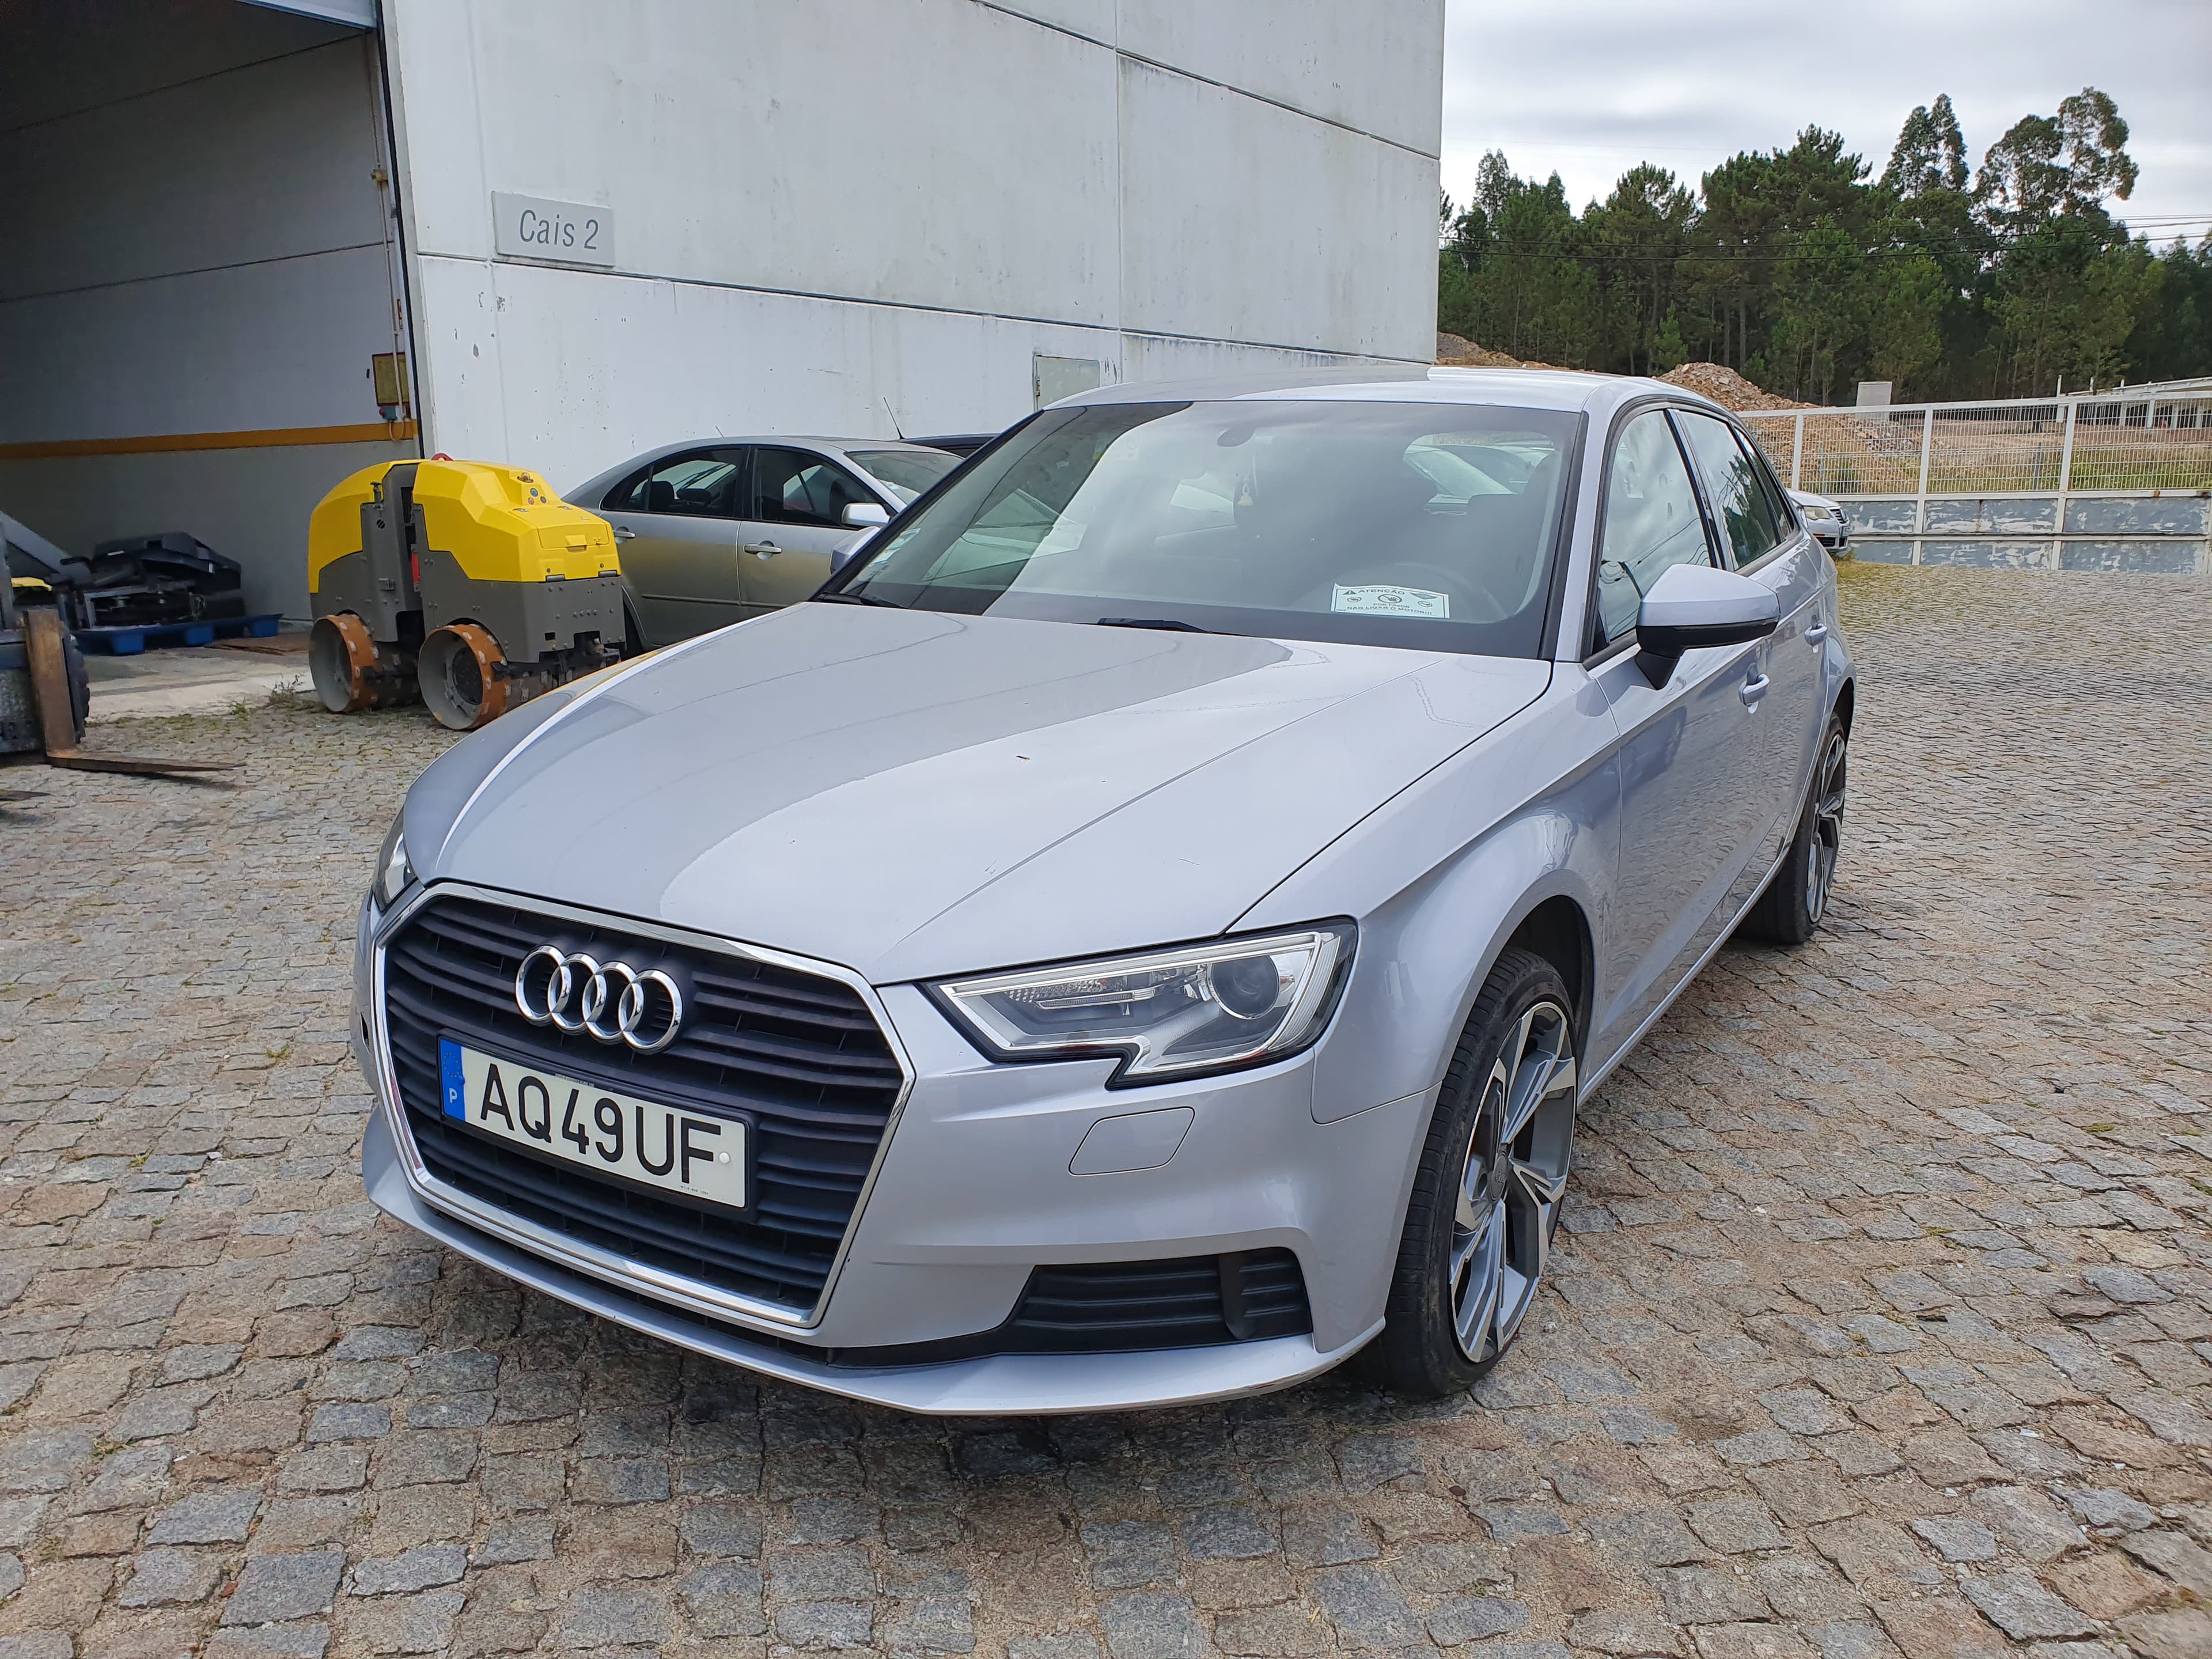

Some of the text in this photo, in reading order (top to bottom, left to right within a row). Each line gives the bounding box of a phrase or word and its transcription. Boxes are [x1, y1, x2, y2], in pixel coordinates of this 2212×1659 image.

[520, 209, 599, 250] Cais 2
[449, 1088, 457, 1103] P
